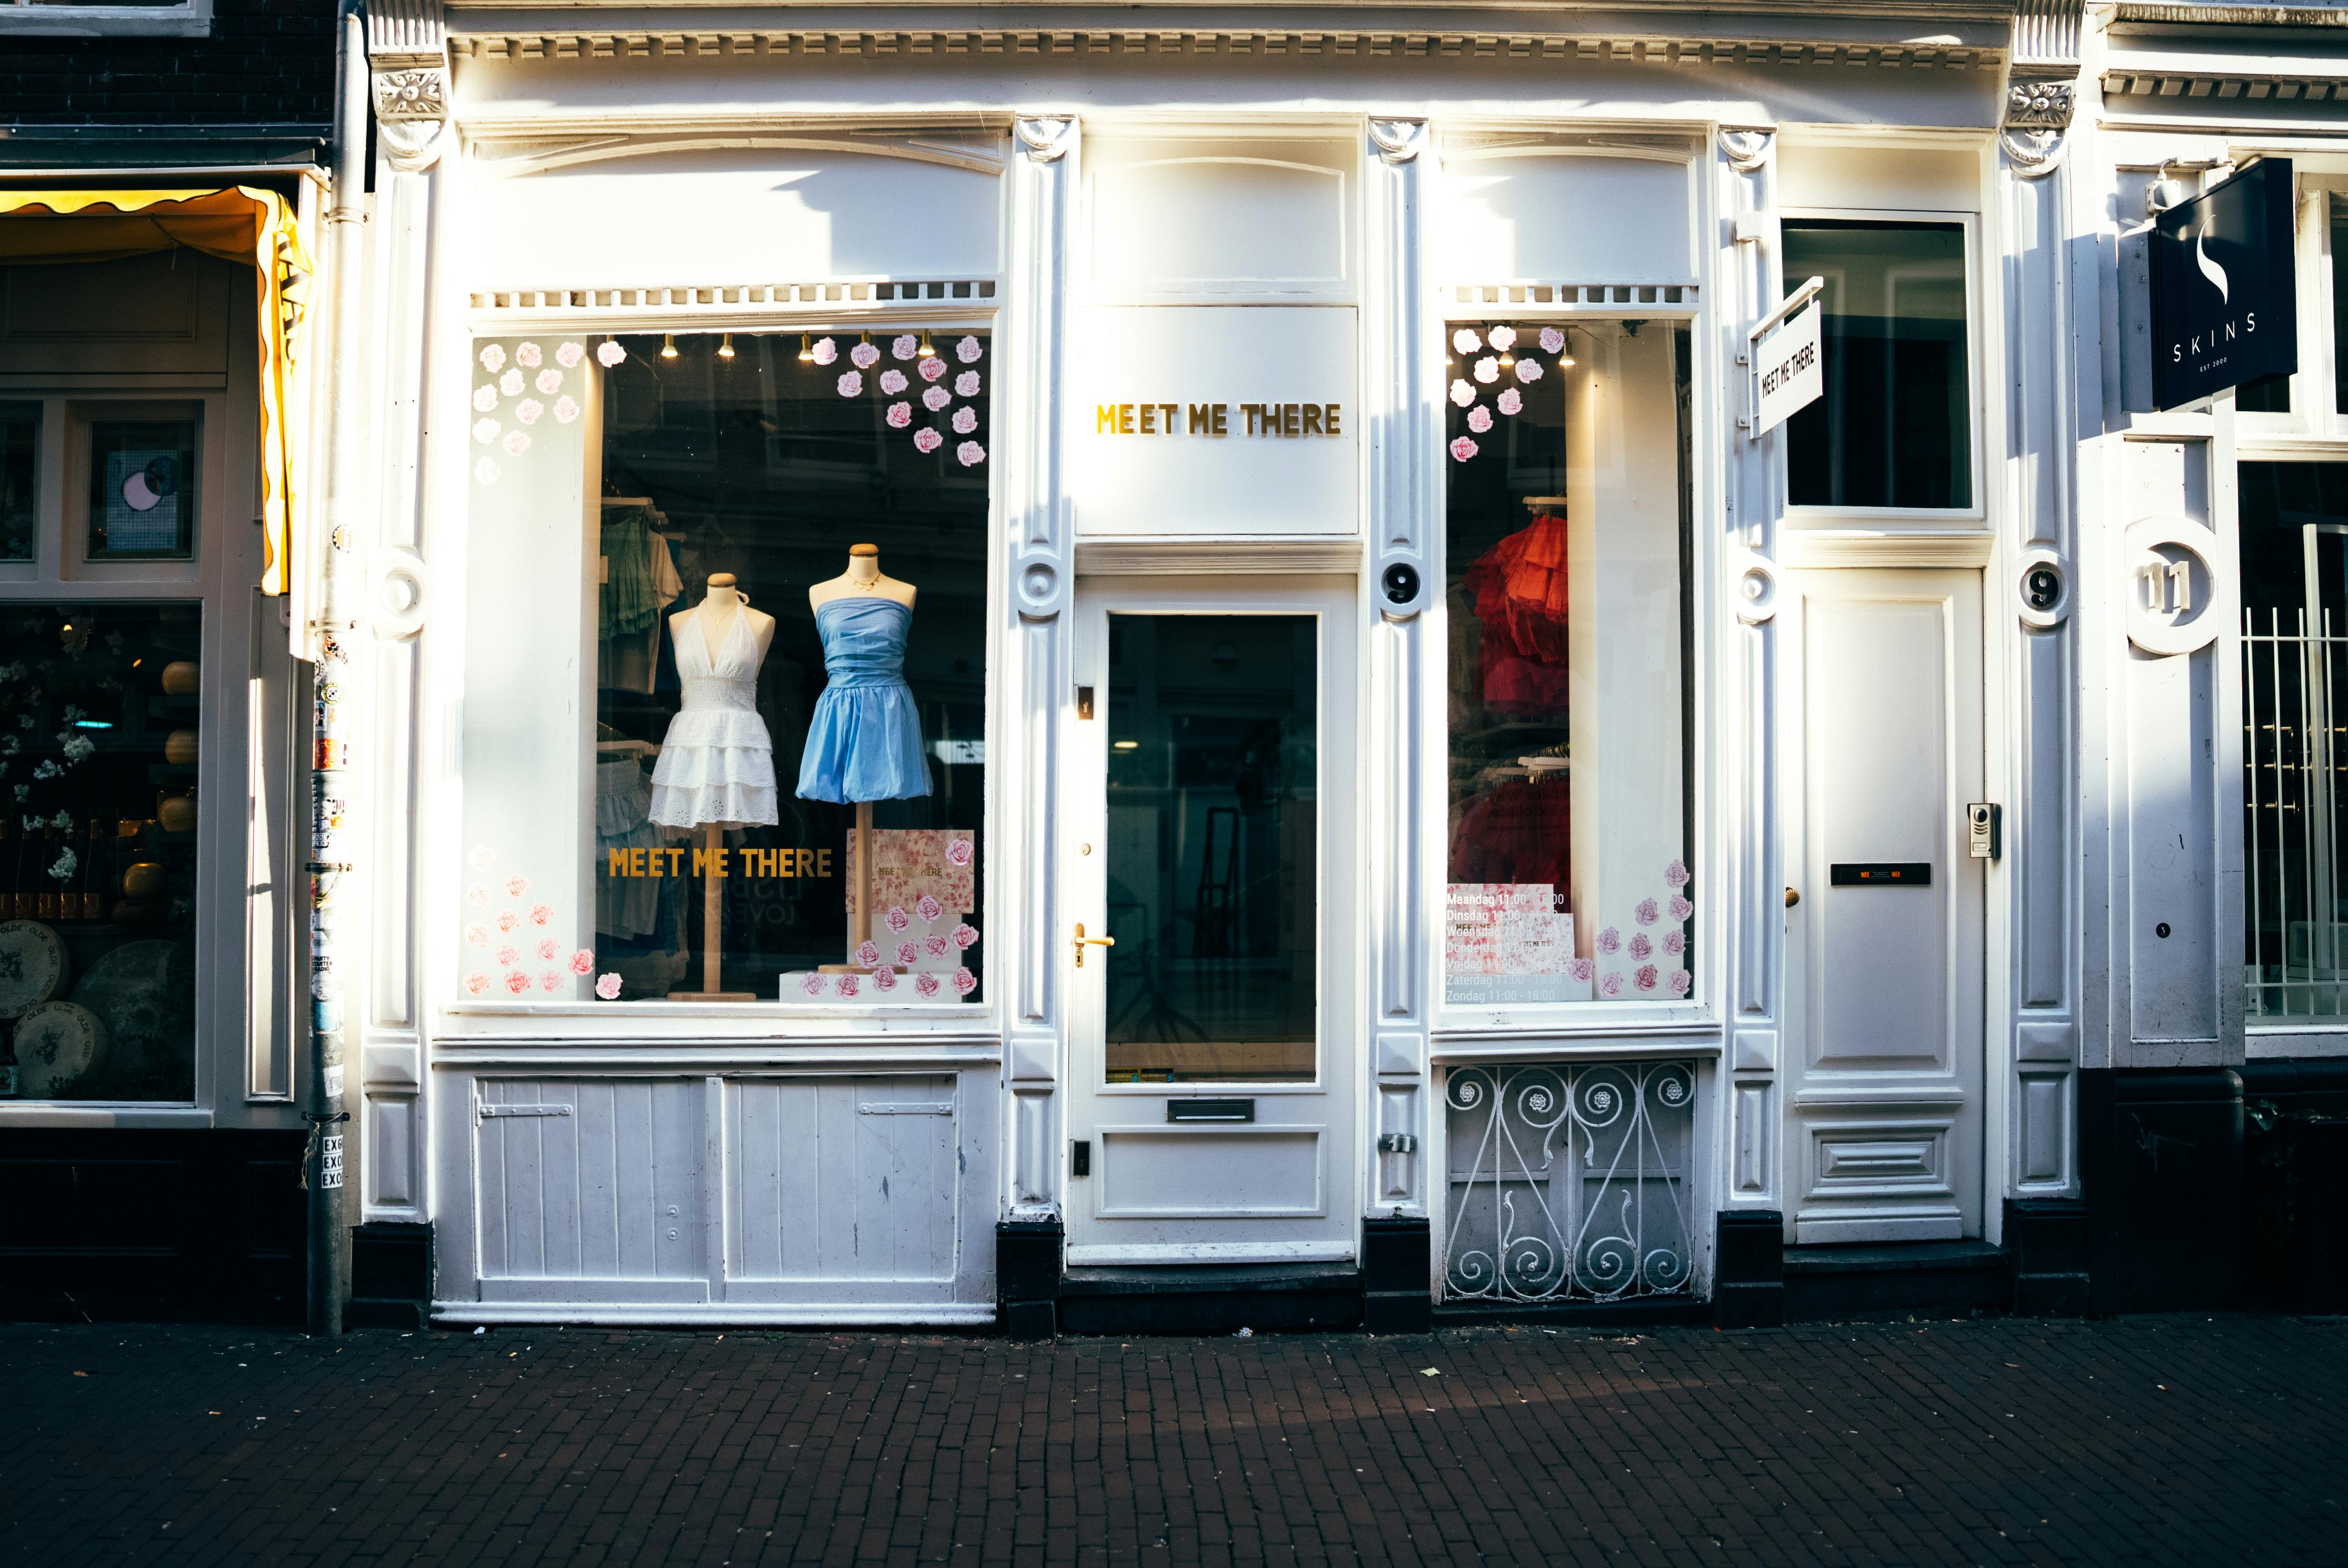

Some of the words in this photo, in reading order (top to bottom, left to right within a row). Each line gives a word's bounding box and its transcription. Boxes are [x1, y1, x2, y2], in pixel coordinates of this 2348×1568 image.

[2174, 312, 2256, 363] SKINS
[1762, 367, 1779, 398] MEET
[1781, 360, 1790, 385] ME
[1791, 341, 1814, 376] THERE
[2200, 364, 2210, 372] EST
[2213, 357, 2227, 368] 2000
[1096, 404, 1178, 434] MEET
[1188, 404, 1227, 434] ME
[1240, 404, 1341, 434] THERE
[1387, 566, 1418, 604] 9
[2030, 571, 2059, 607] 9
[2143, 560, 2190, 613] 11
[609, 848, 683, 878] MEET
[693, 848, 729, 878] ME
[739, 848, 832, 878] THERE
[916, 868, 943, 876] HERE
[1447, 894, 1495, 907] Maandag
[1498, 894, 1527, 905] 11:00
[1537, 894, 1564, 905] 1800
[1446, 910, 1489, 923] Dinsdag
[1492, 910, 1520, 921] 11:00
[1, 925, 23, 934] OLDE
[29, 927, 48, 942] OLDE
[1446, 926, 1501, 940] Woensdag
[1446, 942, 1502, 955] Donderdag
[48, 946, 58, 968] OLDE
[1446, 959, 1482, 972] Vrijdag
[40, 973, 56, 996] OLDE
[1446, 975, 1492, 987] Zaterdag
[1497, 975, 1524, 985] 11:00
[1535, 975, 1562, 985] 18:00
[1446, 991, 1486, 1003] Zondag
[1489, 991, 1517, 1001] 11:00
[1528, 991, 1554, 1001] 18:00
[16, 998, 37, 1014] OLDE
[27, 1005, 48, 1020] OLDE
[77, 1015, 90, 1034] OLDE
